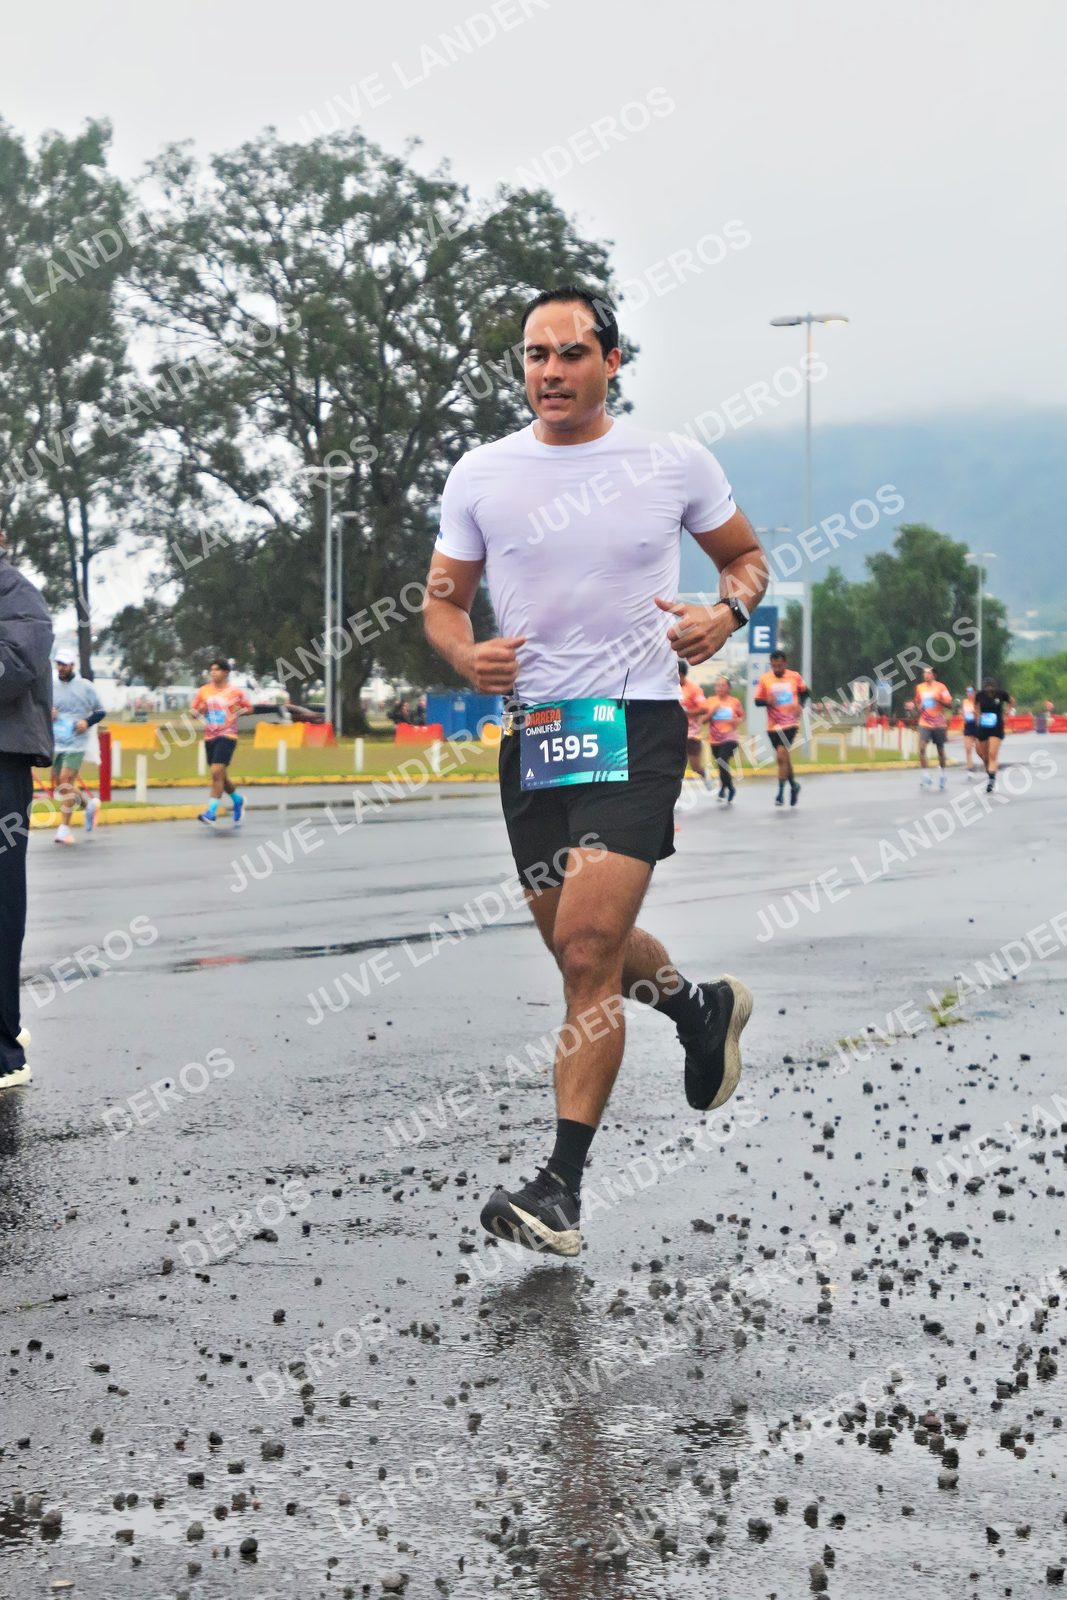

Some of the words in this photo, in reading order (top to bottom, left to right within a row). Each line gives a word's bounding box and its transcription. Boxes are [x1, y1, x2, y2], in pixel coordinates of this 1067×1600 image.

[753, 626, 771, 648] E
[593, 704, 616, 722] 10K
[539, 734, 599, 763] 1595
